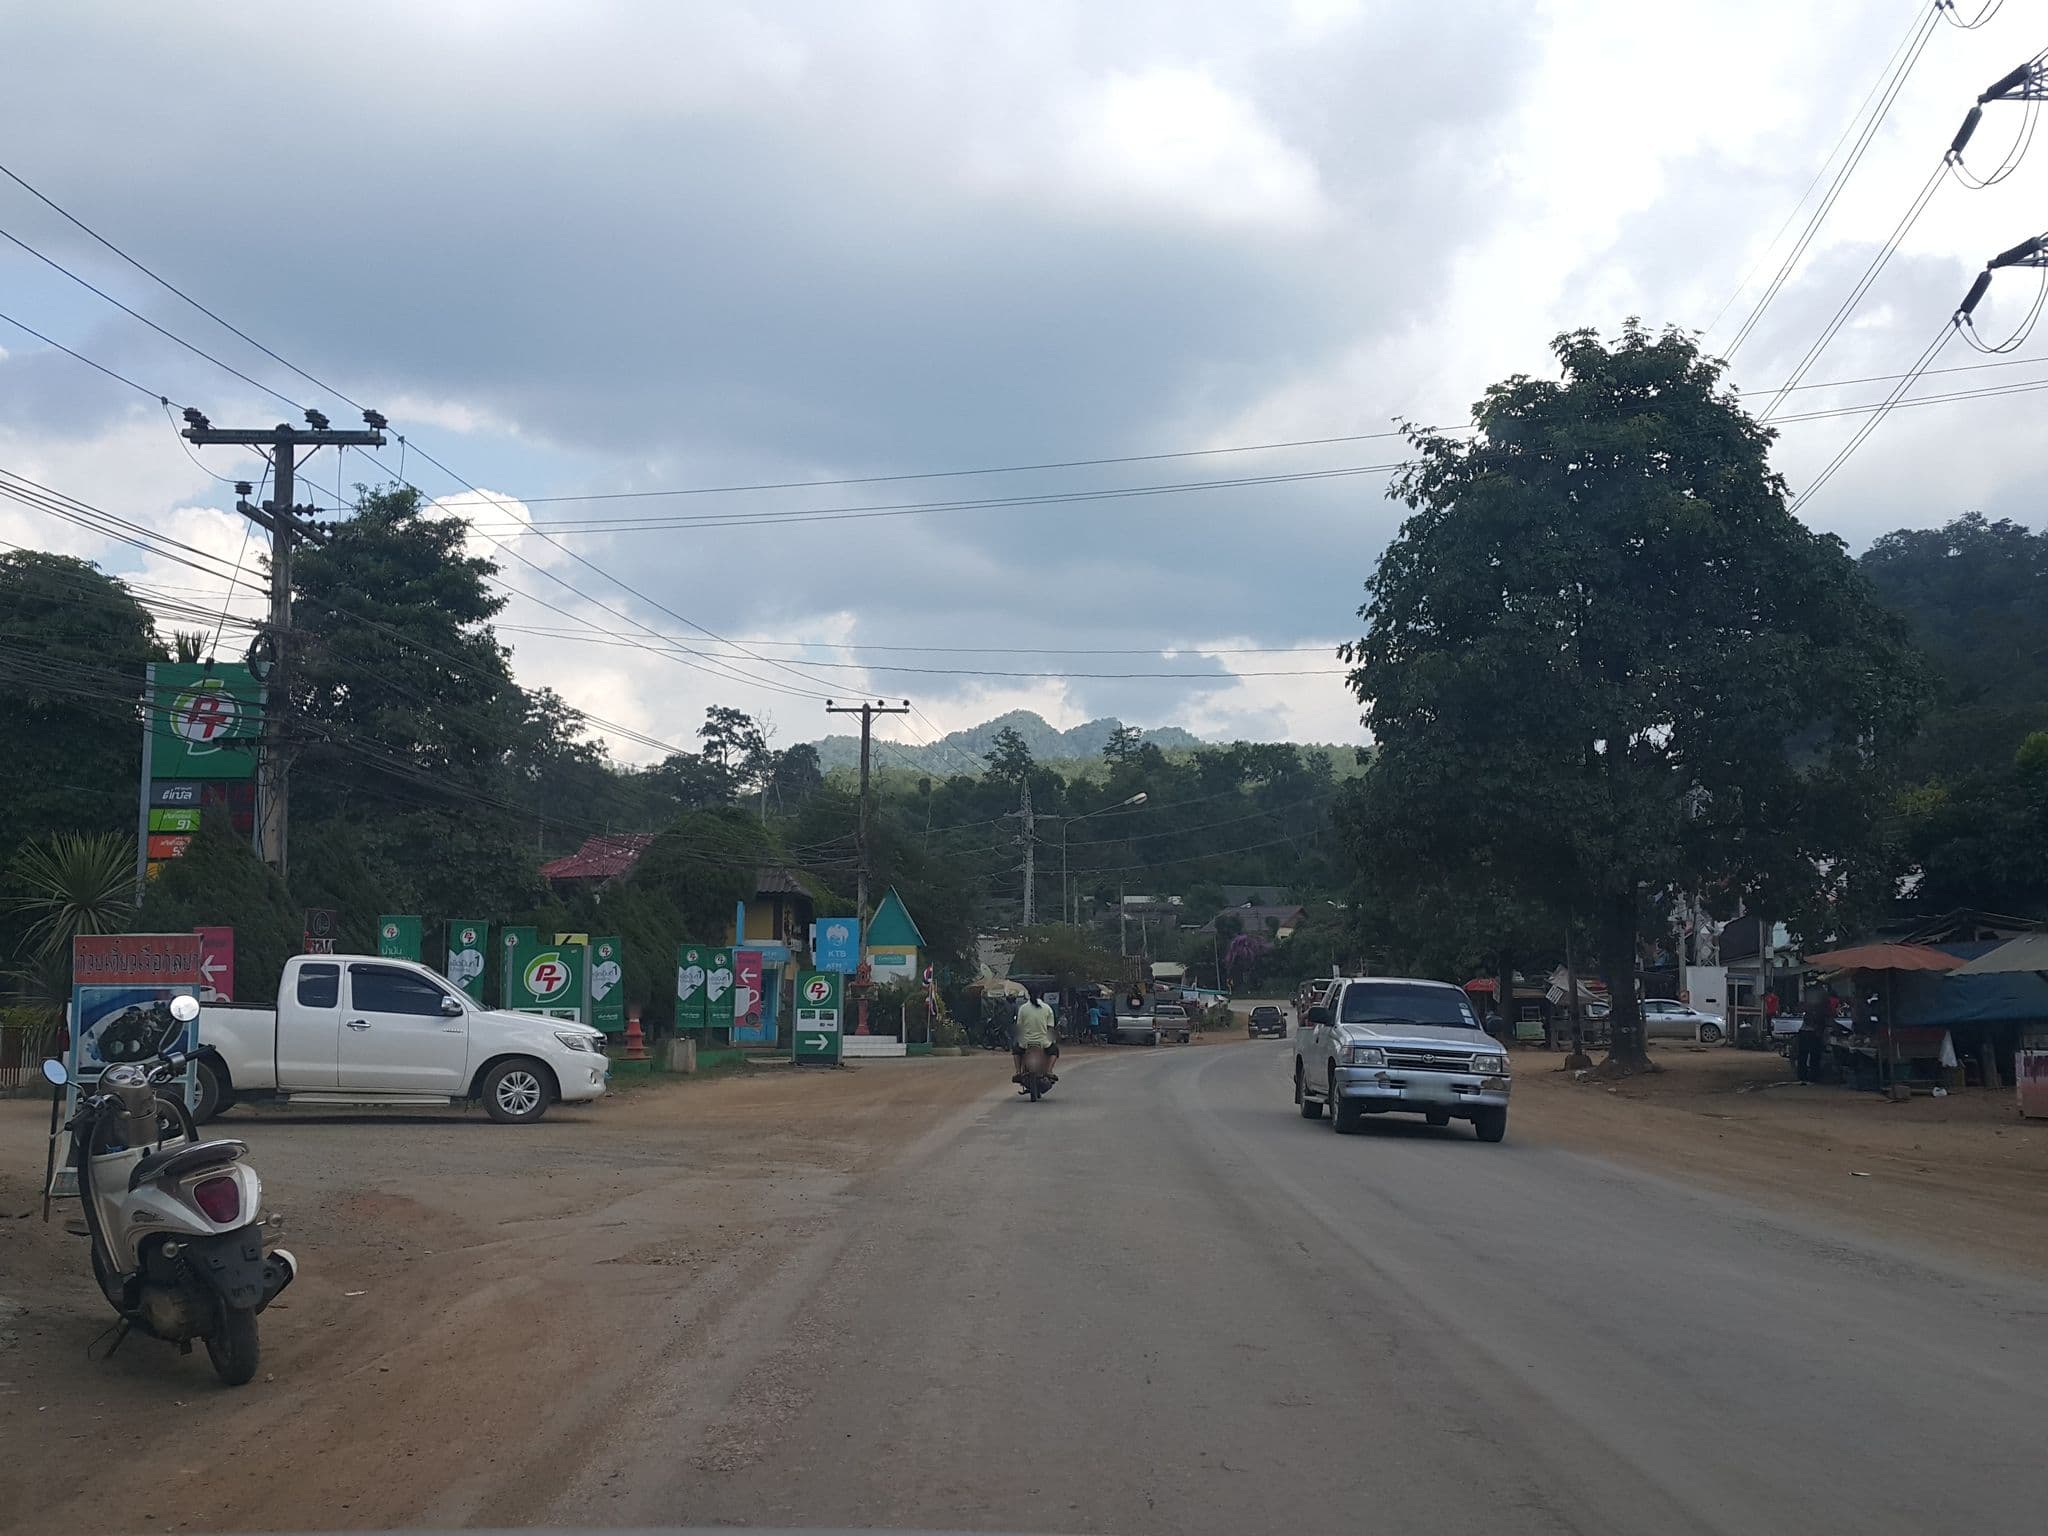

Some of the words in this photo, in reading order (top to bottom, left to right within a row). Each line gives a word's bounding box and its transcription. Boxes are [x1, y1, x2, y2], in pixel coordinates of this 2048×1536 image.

[187, 697, 228, 739] PT
[175, 819, 191, 830] 91
[463, 932, 474, 942] PT
[535, 964, 562, 992] PT
[810, 982, 826, 999] PT
